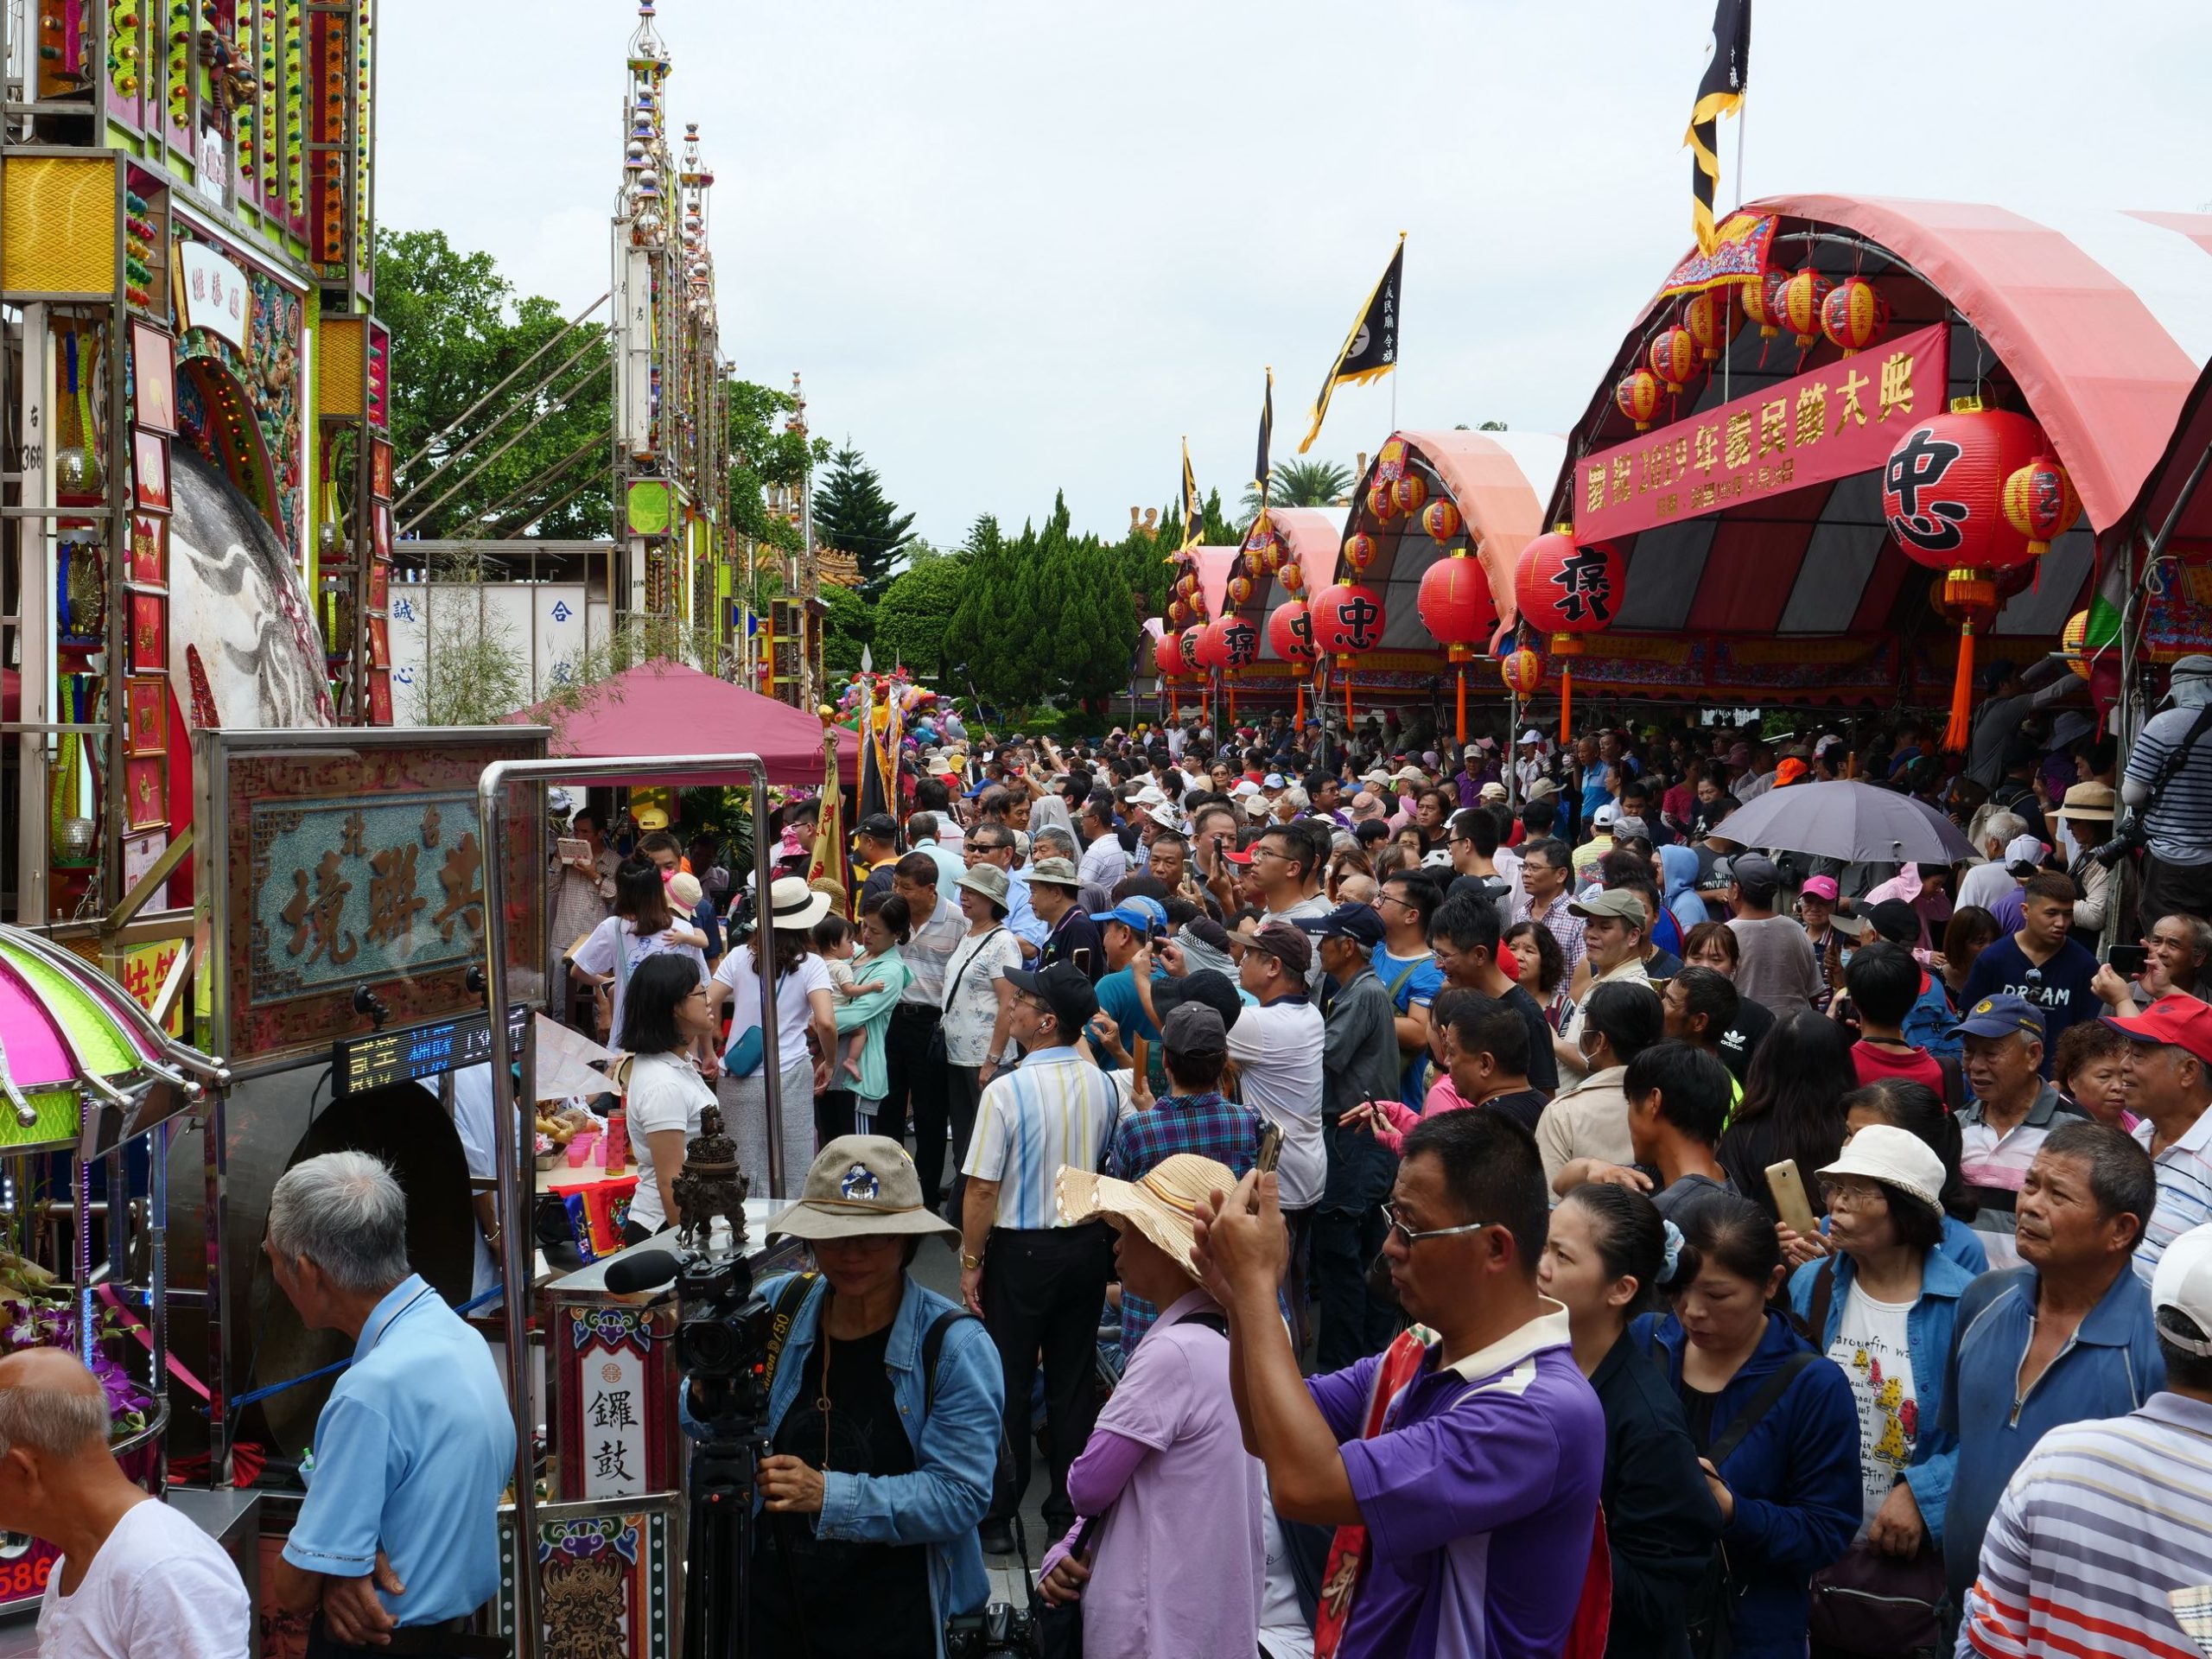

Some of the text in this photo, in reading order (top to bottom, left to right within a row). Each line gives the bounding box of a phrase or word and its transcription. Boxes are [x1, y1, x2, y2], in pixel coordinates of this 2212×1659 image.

[1885, 427, 1969, 553] 忠
[1550, 546, 1611, 623] 褒
[393, 600, 415, 684] 誠心
[1179, 632, 1206, 671] 褒
[1224, 623, 1255, 665] 褒
[1338, 596, 1380, 650] 忠
[1720, 1039, 1744, 1052] adidas
[588, 1389, 639, 1500] 鑼鼓
